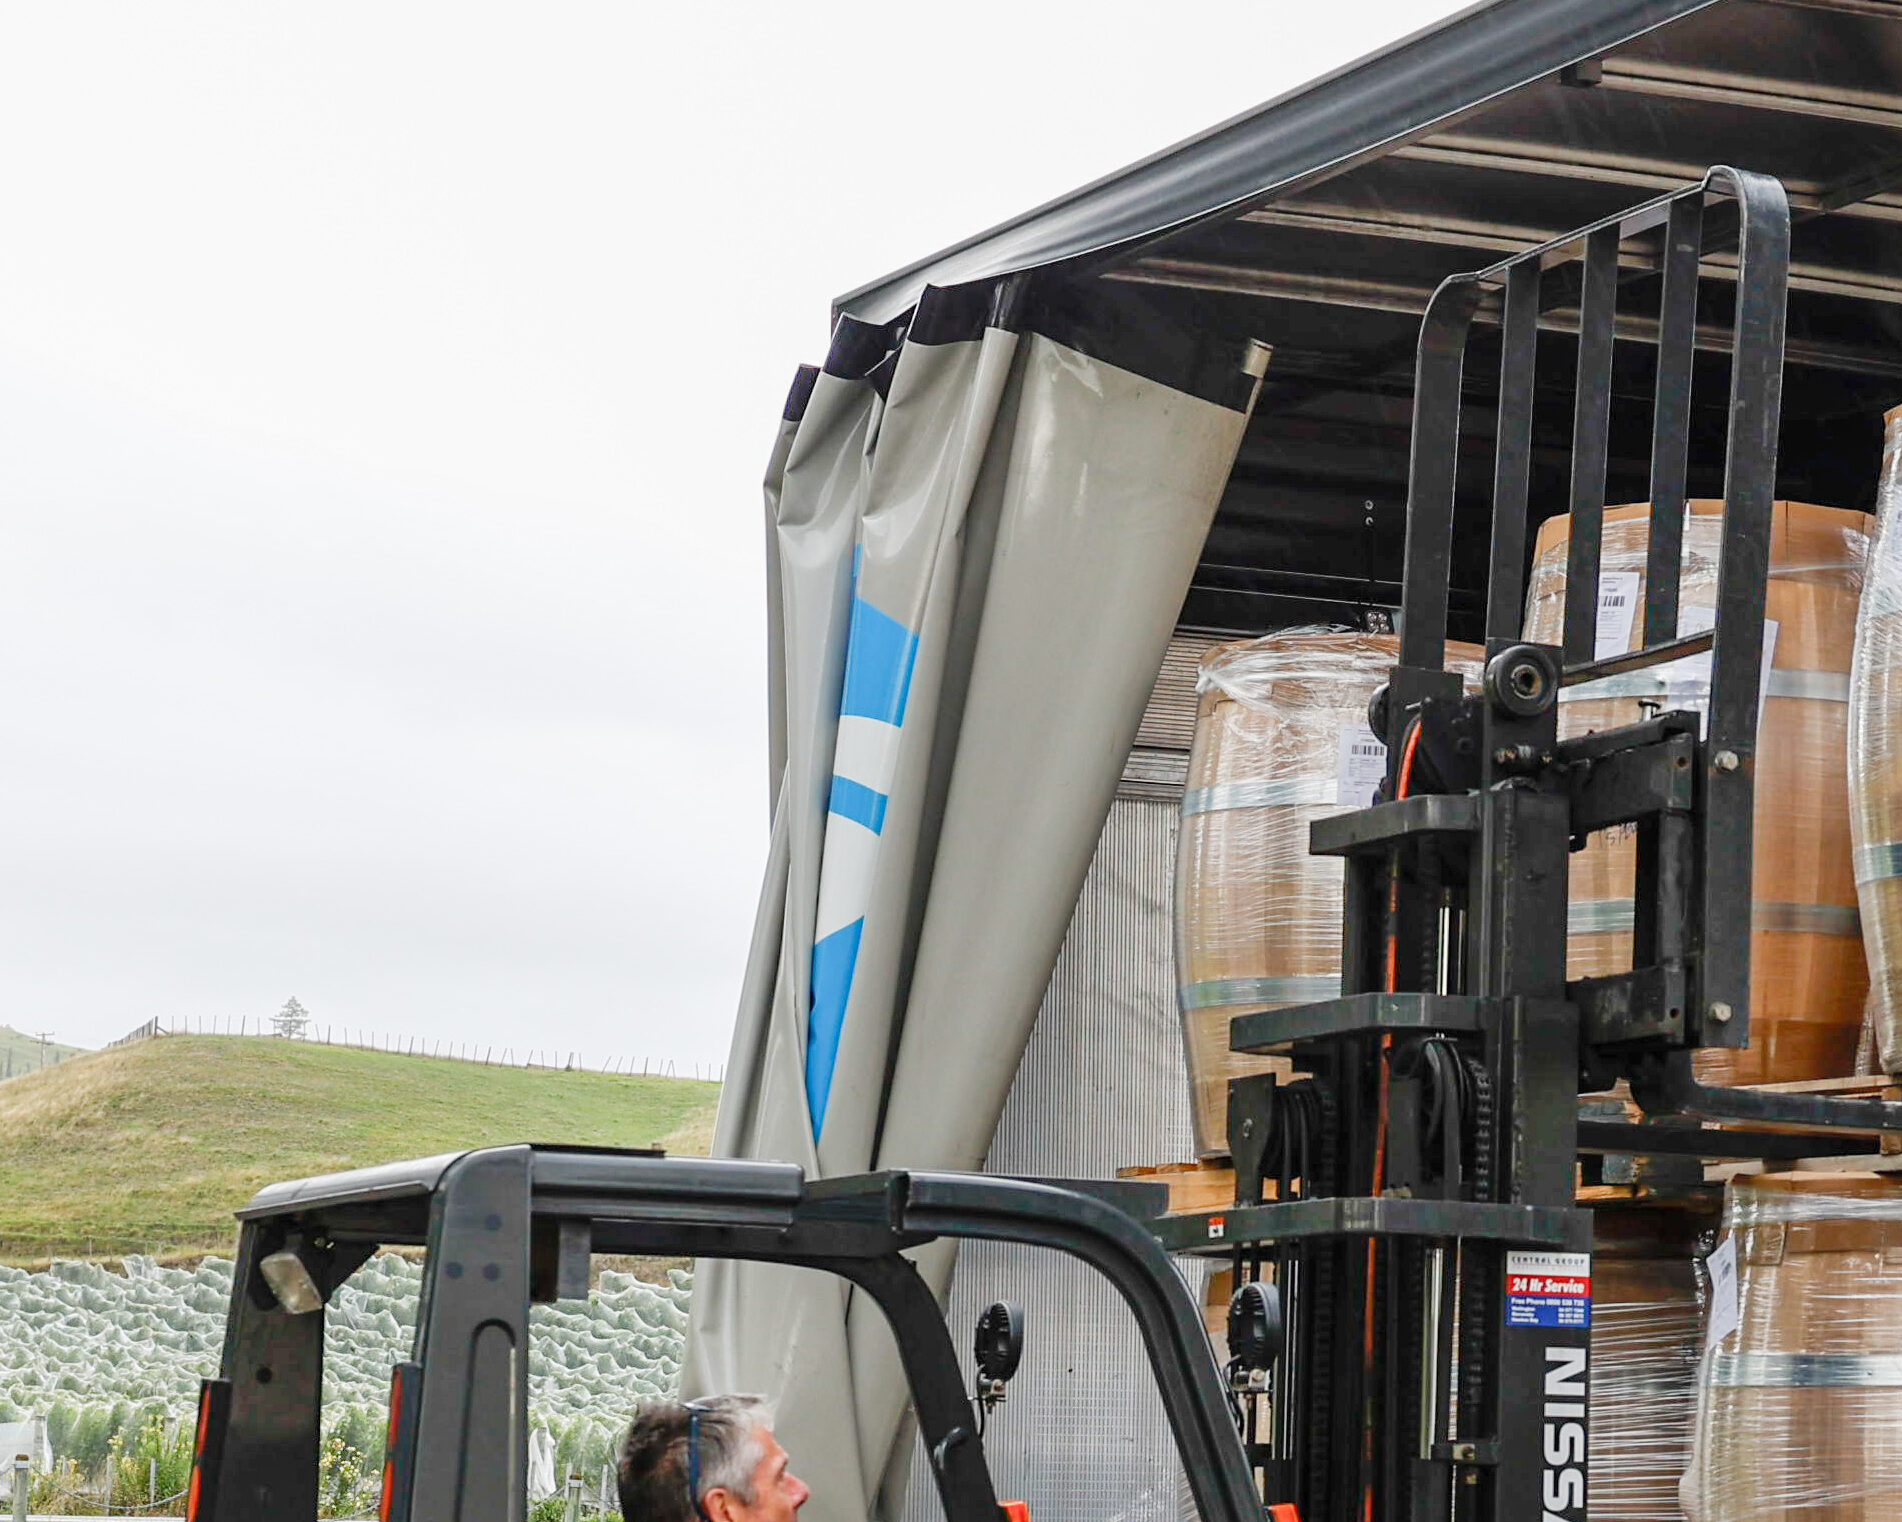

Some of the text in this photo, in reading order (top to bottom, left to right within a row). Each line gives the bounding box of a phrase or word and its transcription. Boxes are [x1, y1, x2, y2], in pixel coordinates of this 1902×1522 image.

[1555, 1258, 1585, 1266] GROUP
[1512, 1277, 1585, 1293] 24 Hr Service
[1526, 1297, 1545, 1305] Phone
